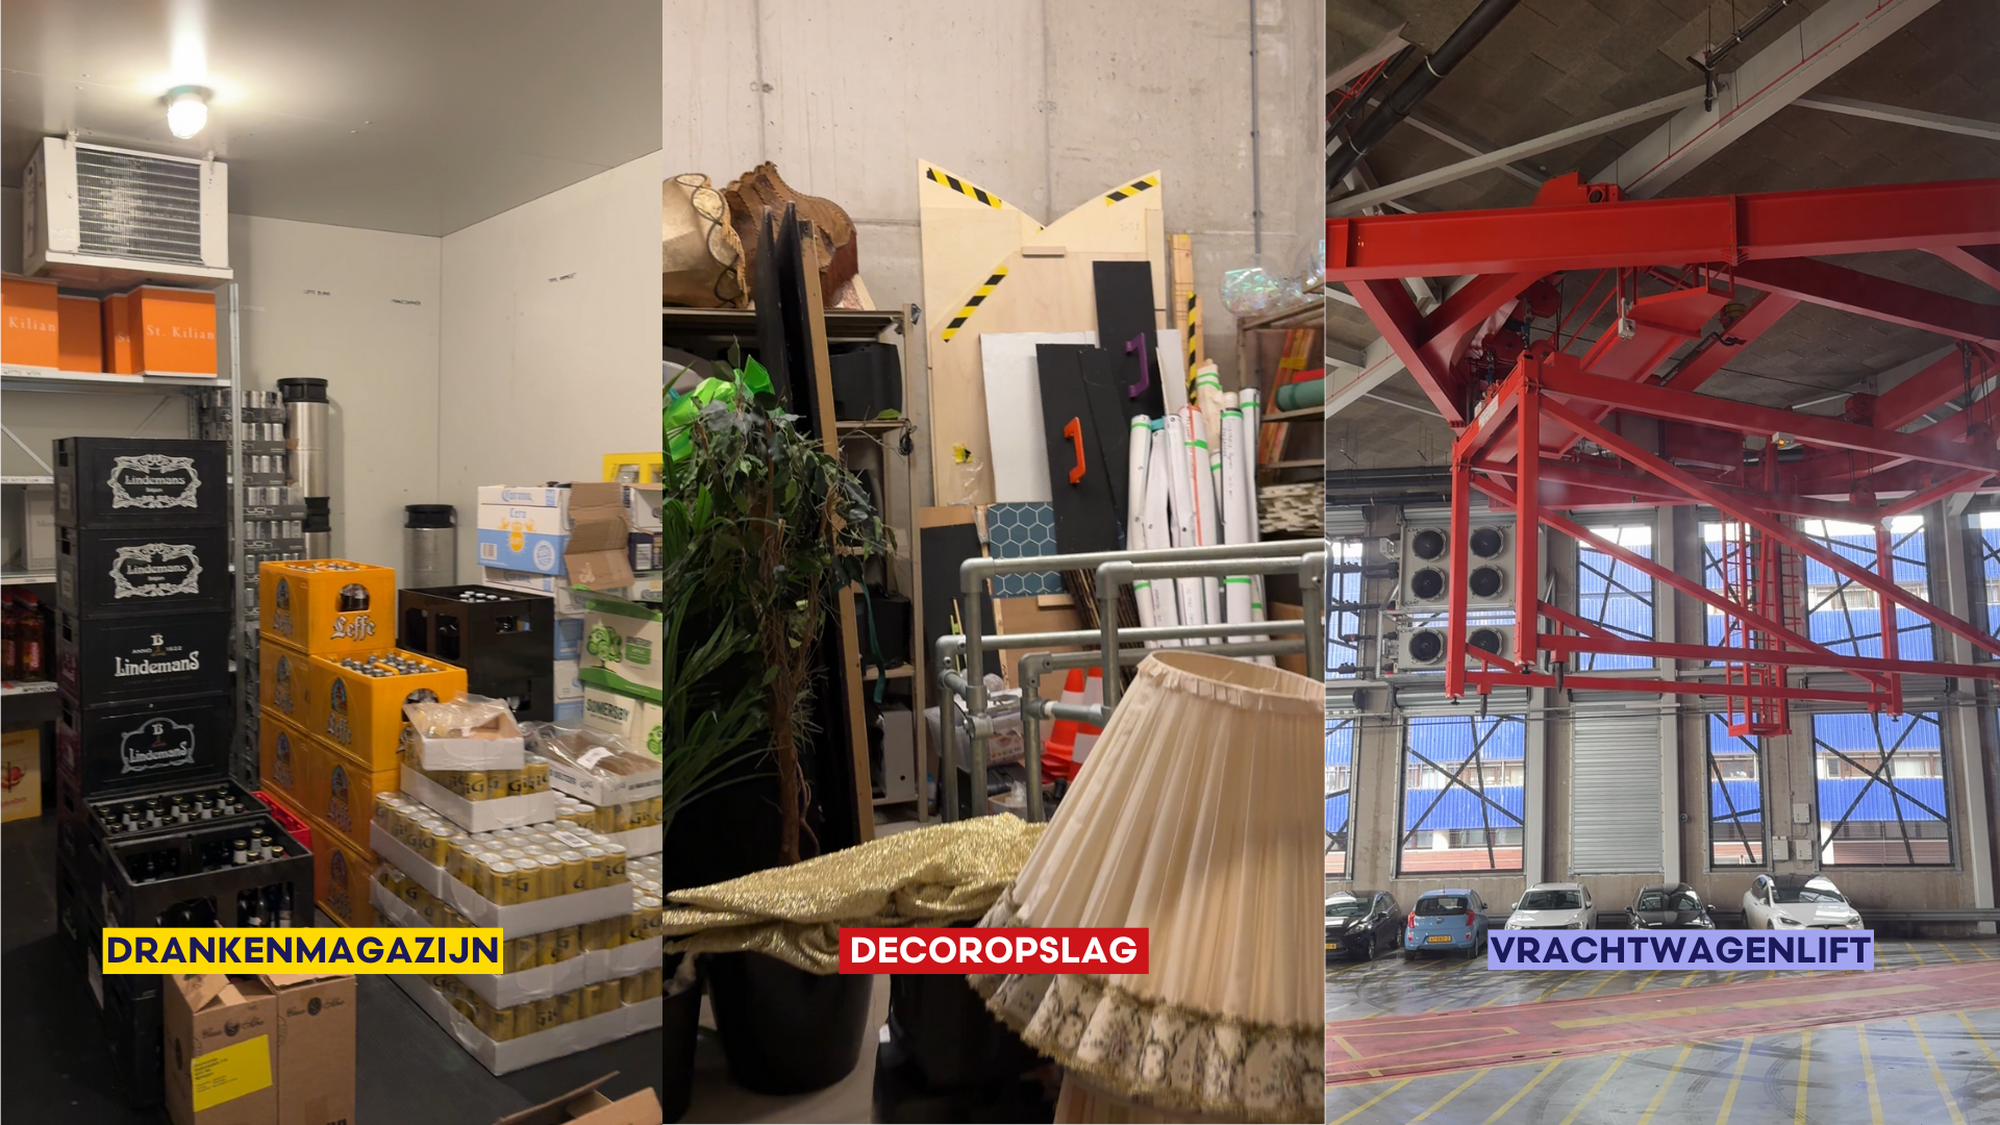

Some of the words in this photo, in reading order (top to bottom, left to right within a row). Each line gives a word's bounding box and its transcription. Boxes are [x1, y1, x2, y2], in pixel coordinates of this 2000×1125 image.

[8, 316, 56, 332] Kilian
[147, 325, 166, 337] St.
[172, 326, 215, 340] Kilian
[124, 475, 186, 485] Lindemans
[501, 489, 534, 502] Corona
[126, 564, 187, 575] Lindemans
[330, 615, 376, 642] Leffe
[586, 698, 630, 723] SOMERSBY
